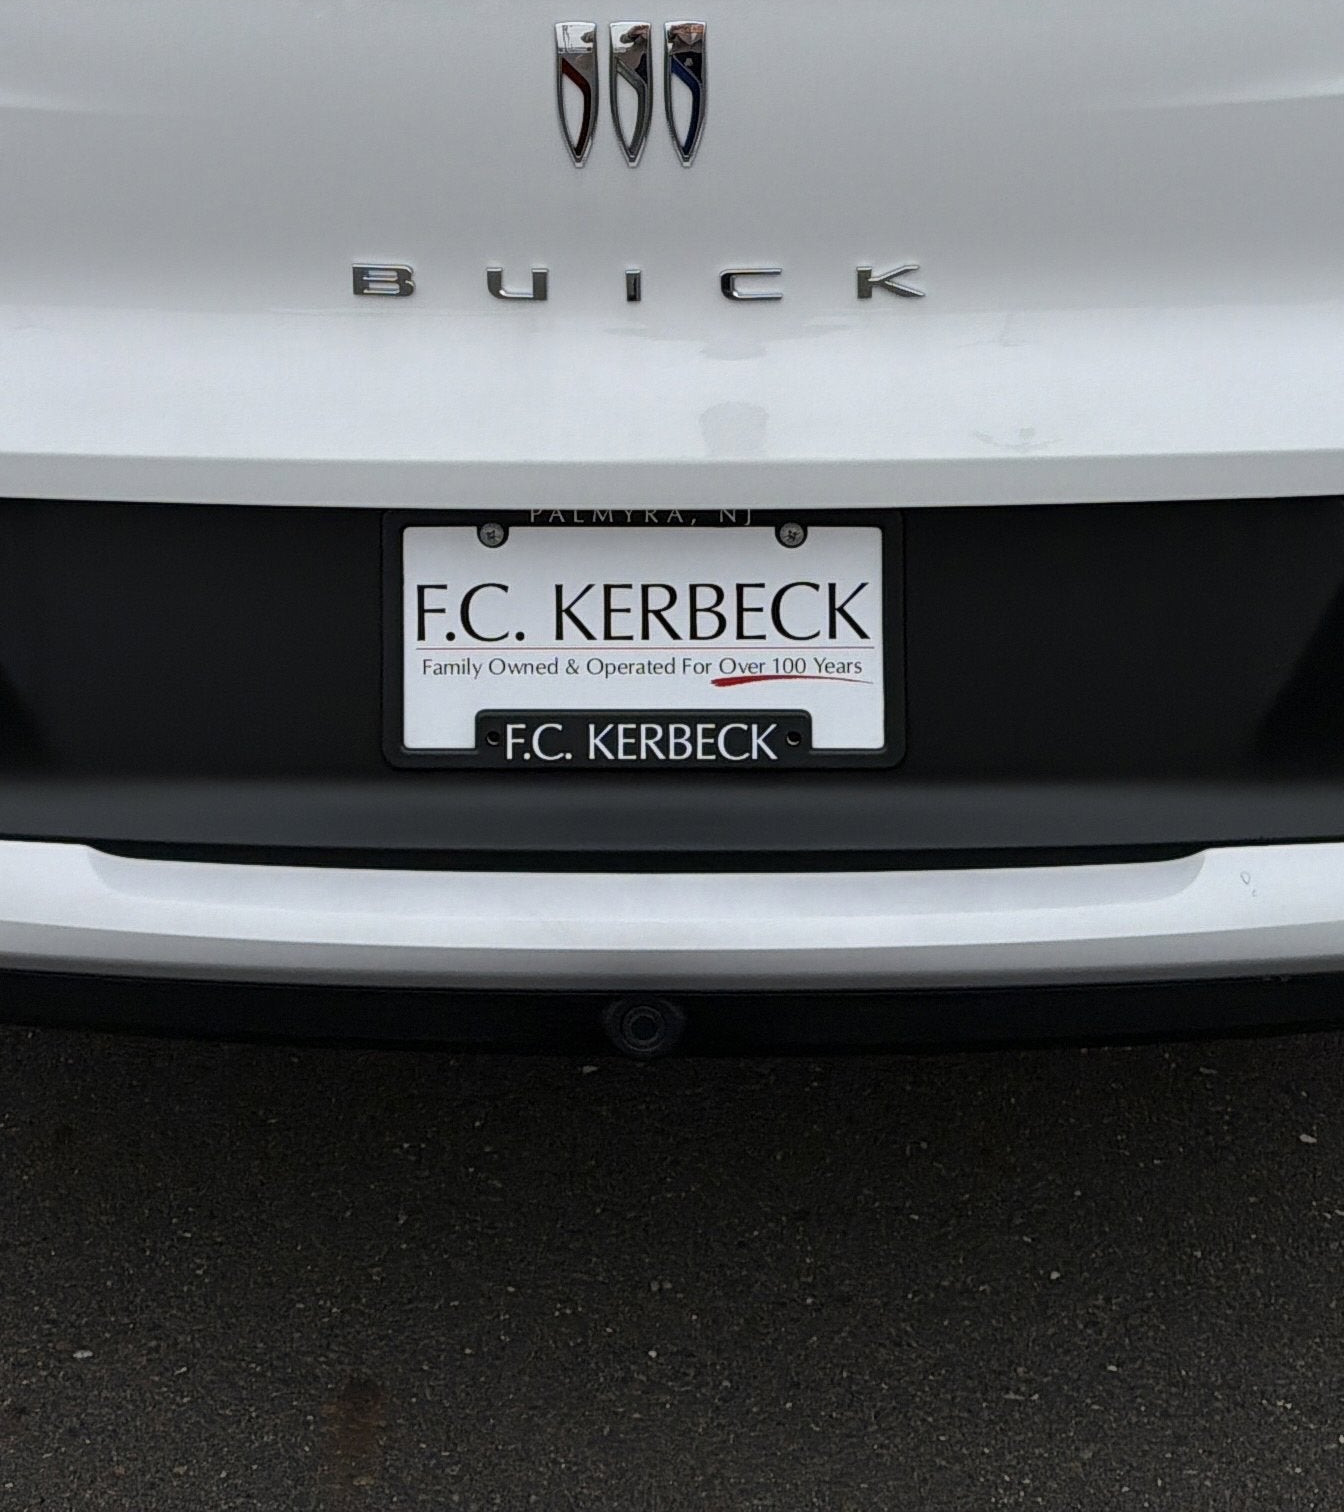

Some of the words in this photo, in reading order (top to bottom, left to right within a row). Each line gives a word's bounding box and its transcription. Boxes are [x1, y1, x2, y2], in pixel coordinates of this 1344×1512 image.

[352, 264, 925, 302] BUICK
[530, 509, 697, 526] PALMYRA,
[719, 509, 751, 526] NJ
[416, 583, 525, 642] F.C.
[555, 582, 870, 641] KERBECK
[422, 657, 483, 679] Family
[488, 656, 559, 676] Owned
[565, 658, 580, 675] &
[586, 656, 676, 679] Operated
[682, 657, 712, 675] For
[718, 657, 766, 675] Over
[772, 657, 807, 674] 100
[813, 656, 863, 675] Years
[506, 723, 573, 761] F.C.
[588, 723, 778, 761] KERBECK
